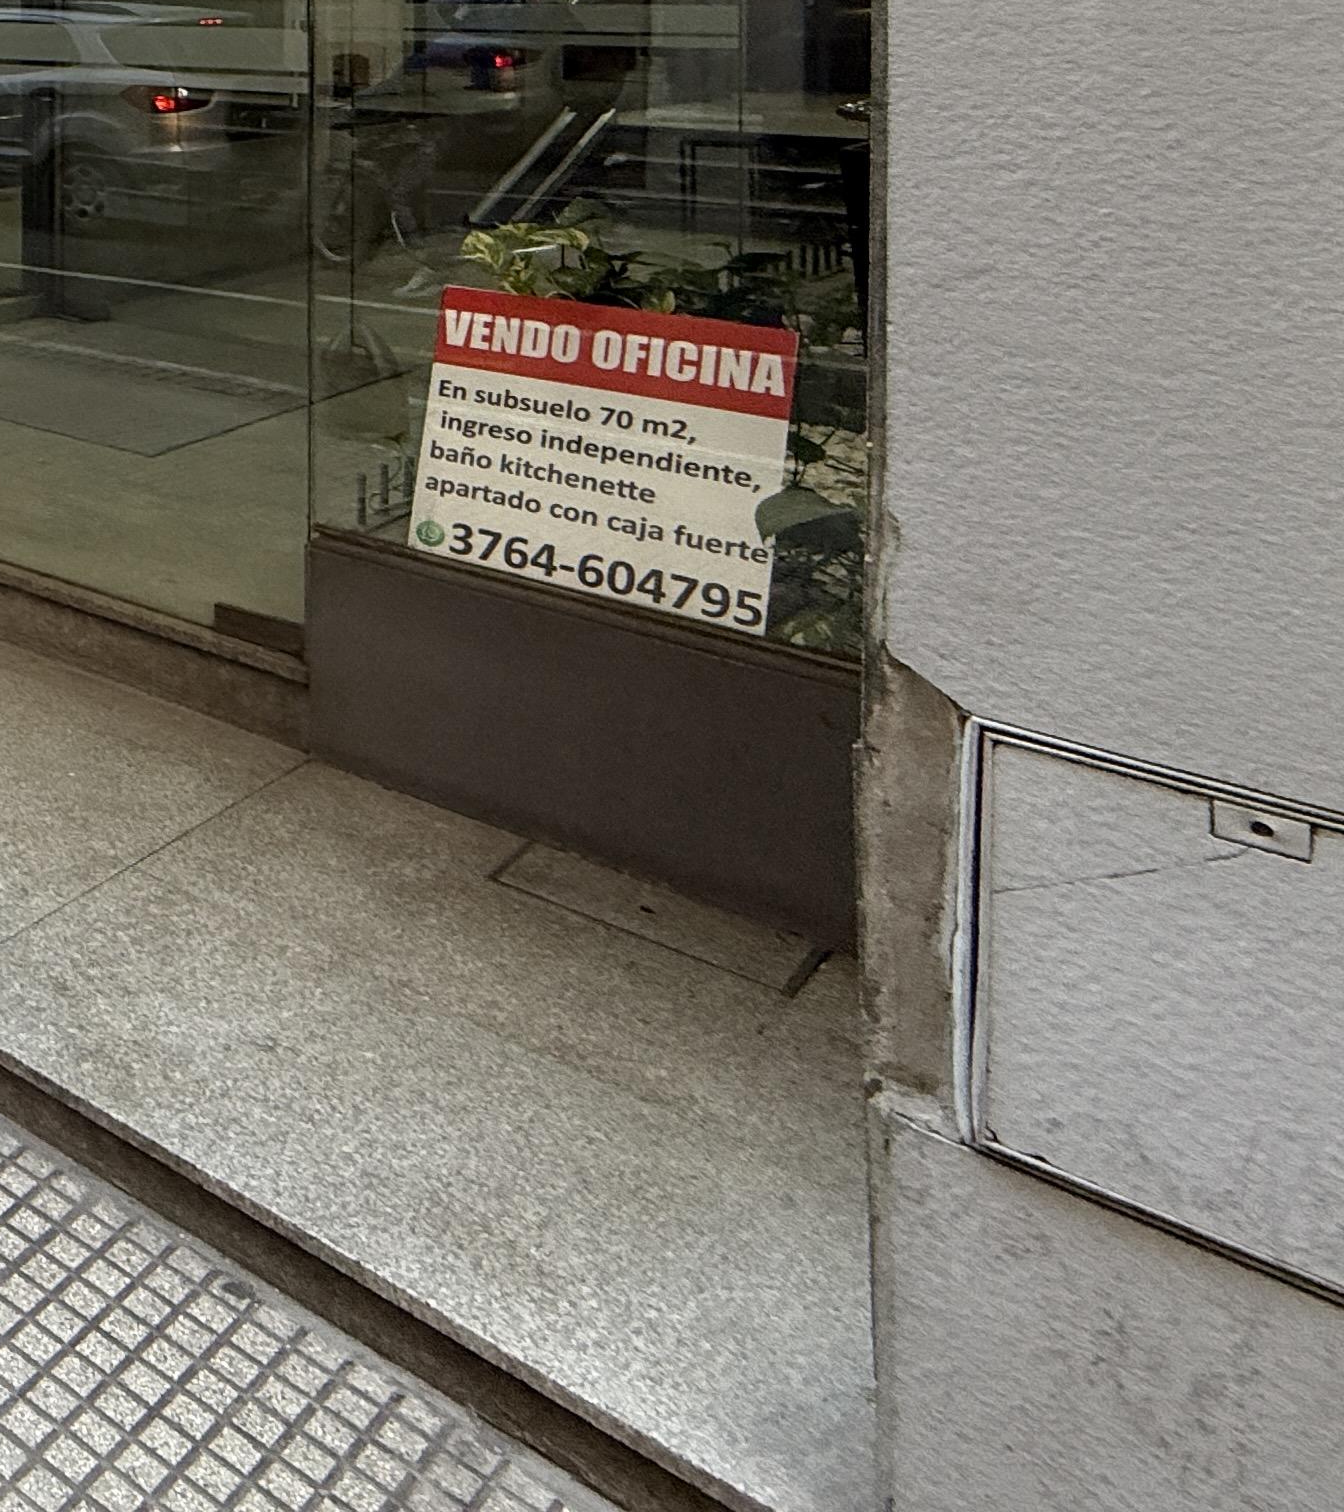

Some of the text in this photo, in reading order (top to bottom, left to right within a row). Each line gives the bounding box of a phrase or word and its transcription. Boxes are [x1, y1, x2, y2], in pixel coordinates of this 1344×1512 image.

[445, 308, 786, 397] VENDO OFICINA
[438, 378, 697, 446] En subsuelo 70 m2,
[440, 410, 762, 493] ingreso independiente,
[429, 440, 657, 504] baño kitchenette
[424, 473, 770, 565] apartado con caja fuerte
[448, 522, 765, 629] 3764-604795
